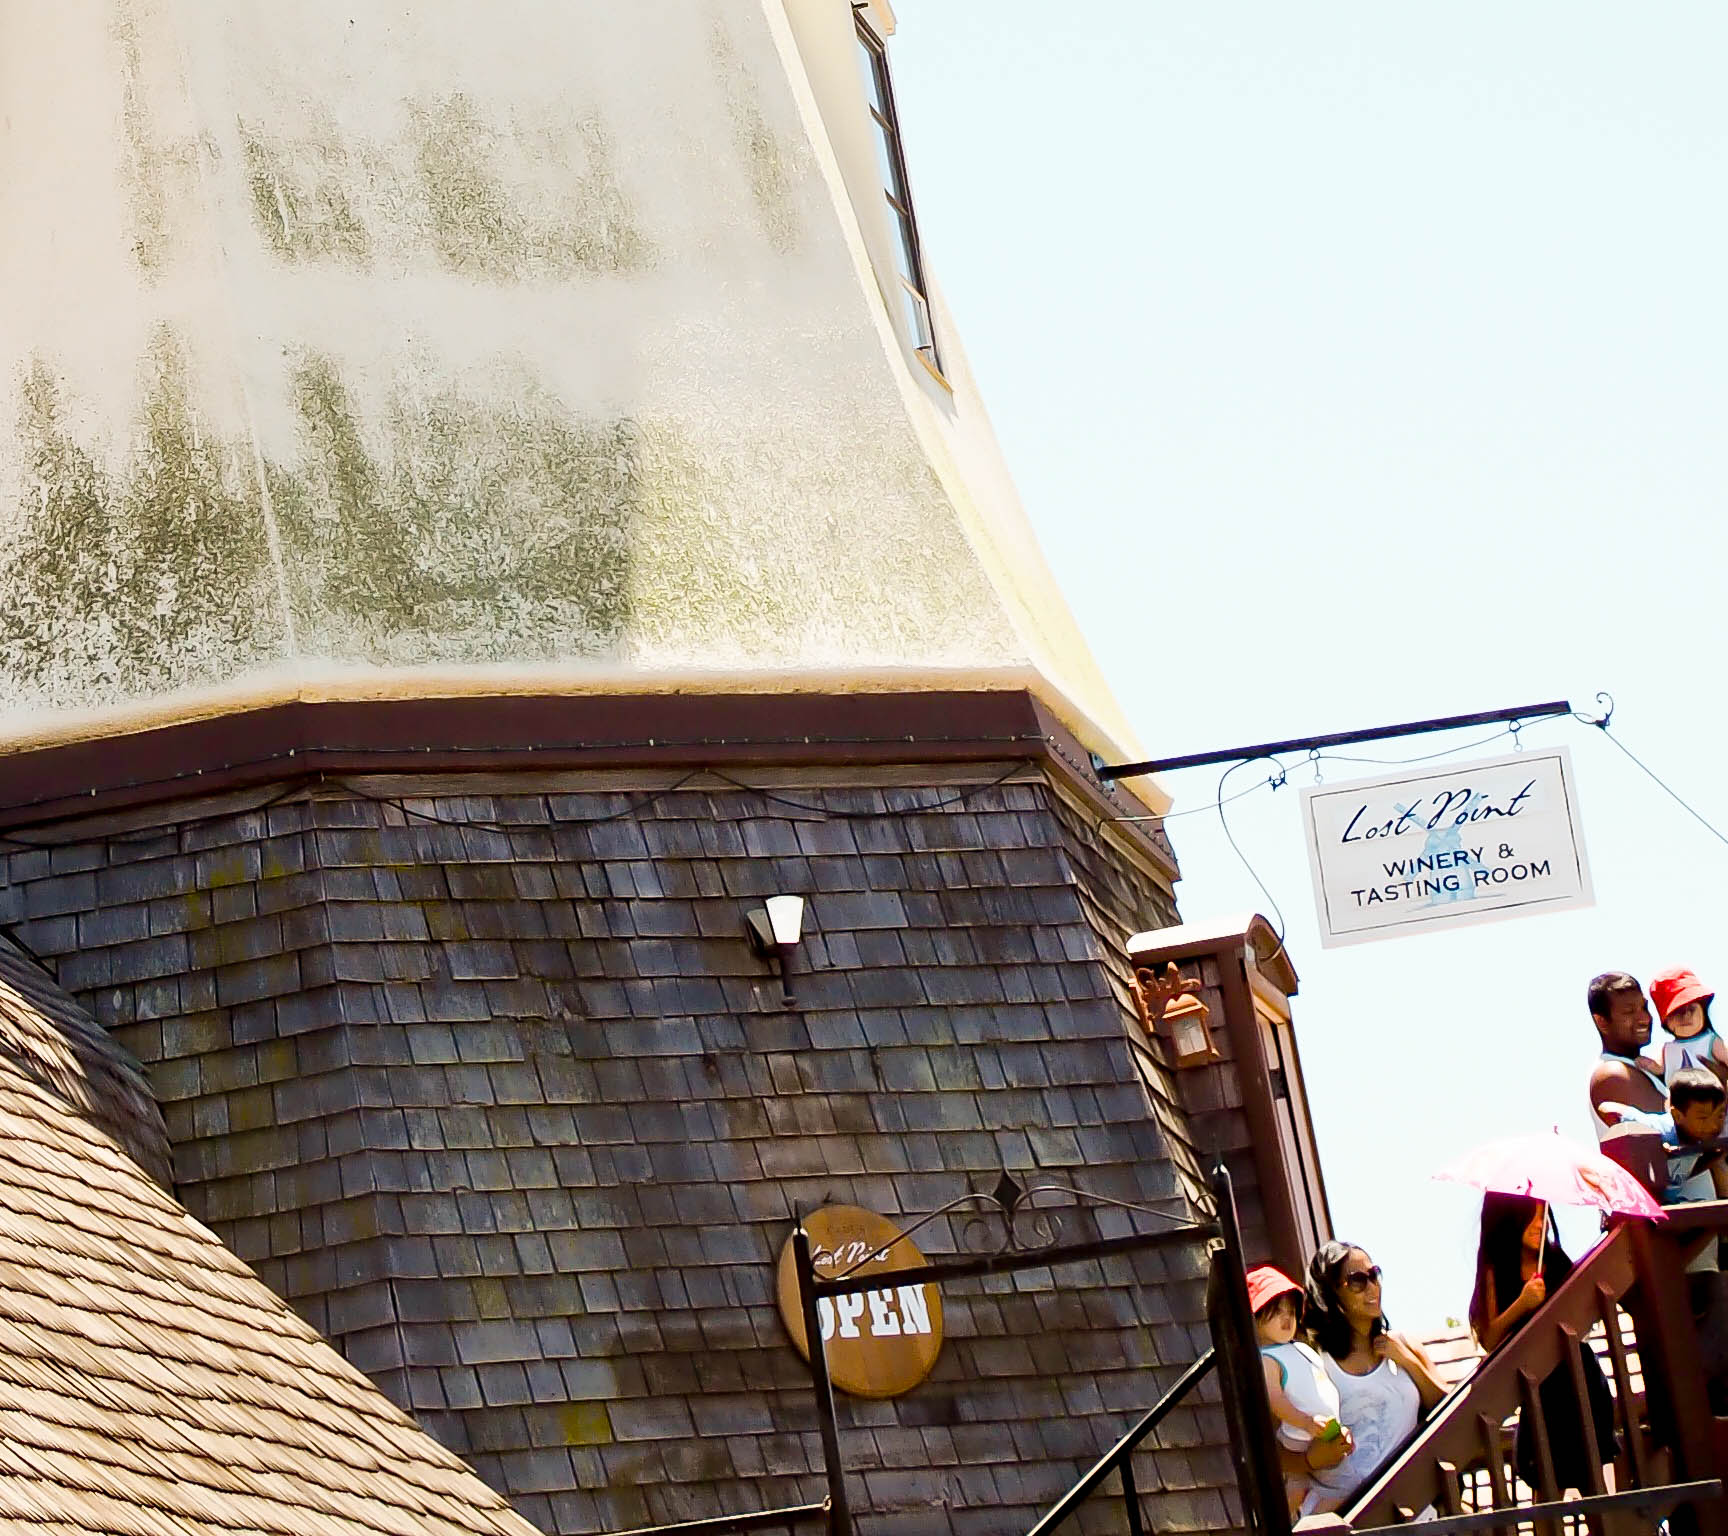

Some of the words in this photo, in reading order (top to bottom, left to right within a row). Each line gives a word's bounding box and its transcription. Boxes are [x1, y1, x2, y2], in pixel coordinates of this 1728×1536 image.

[1342, 799, 1423, 843] Lost
[1427, 779, 1536, 830] Point
[1351, 875, 1460, 906] TASTING
[1473, 860, 1551, 886] ROOM
[1383, 846, 1484, 877] WINERY
[1498, 843, 1515, 859] &
